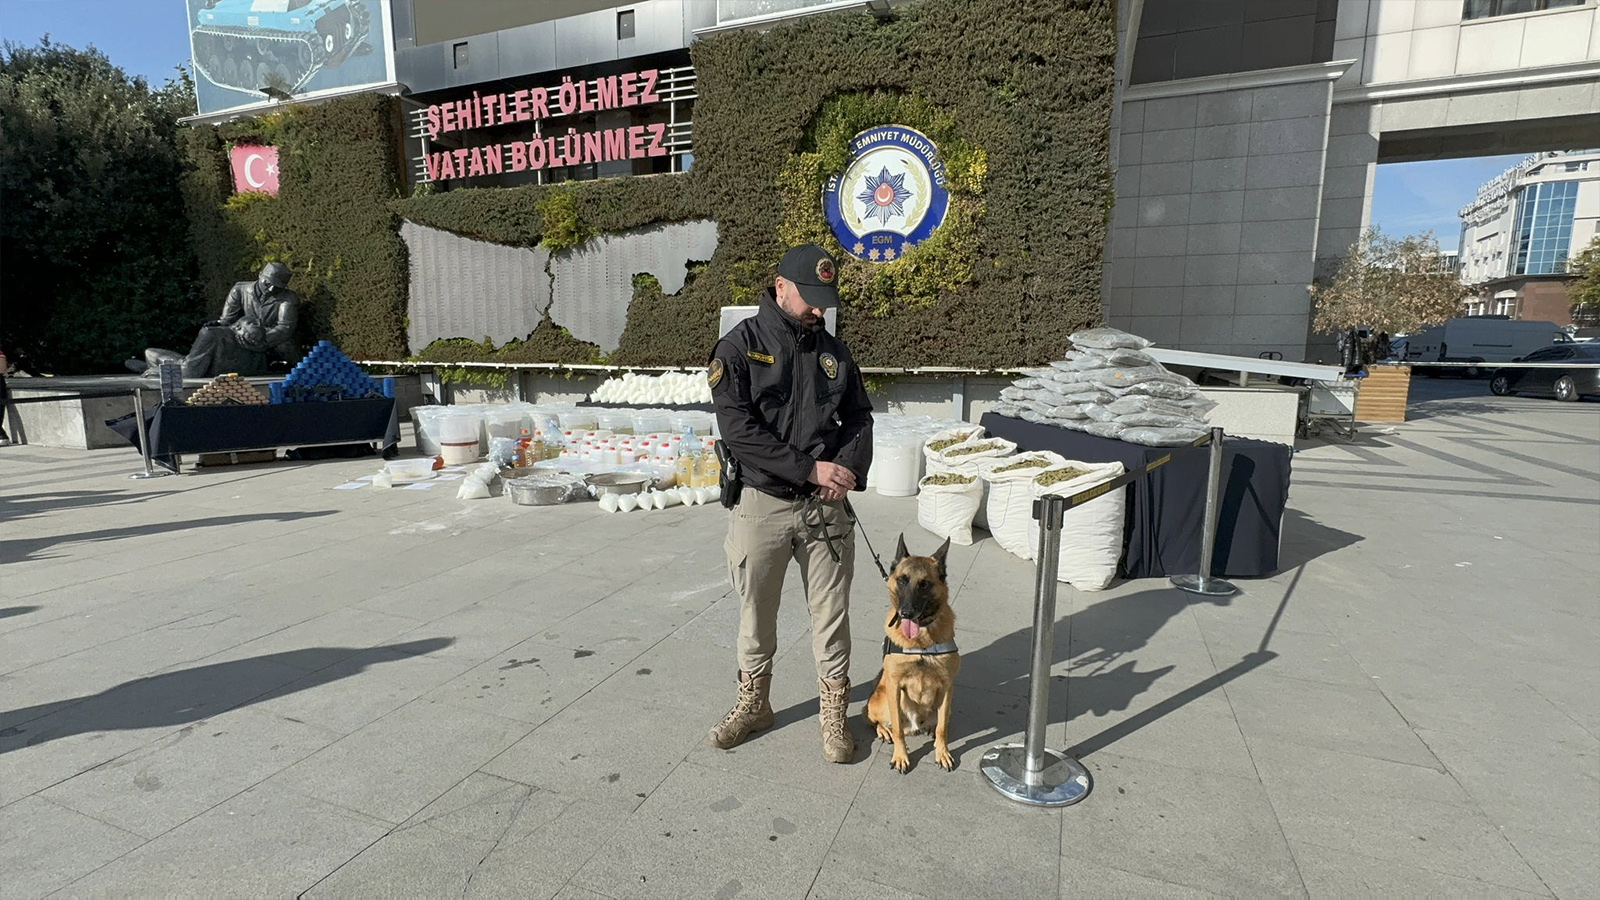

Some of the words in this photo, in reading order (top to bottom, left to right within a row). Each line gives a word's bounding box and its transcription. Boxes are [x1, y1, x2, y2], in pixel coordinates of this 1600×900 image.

[426, 87, 549, 141] ŞEHİTLER
[558, 69, 660, 115] ÖLMEZ
[425, 143, 503, 181] VATAN
[511, 123, 667, 171] BÖLÜNMEZ
[856, 131, 899, 149] EMNİYET
[872, 235, 893, 244] EGM
